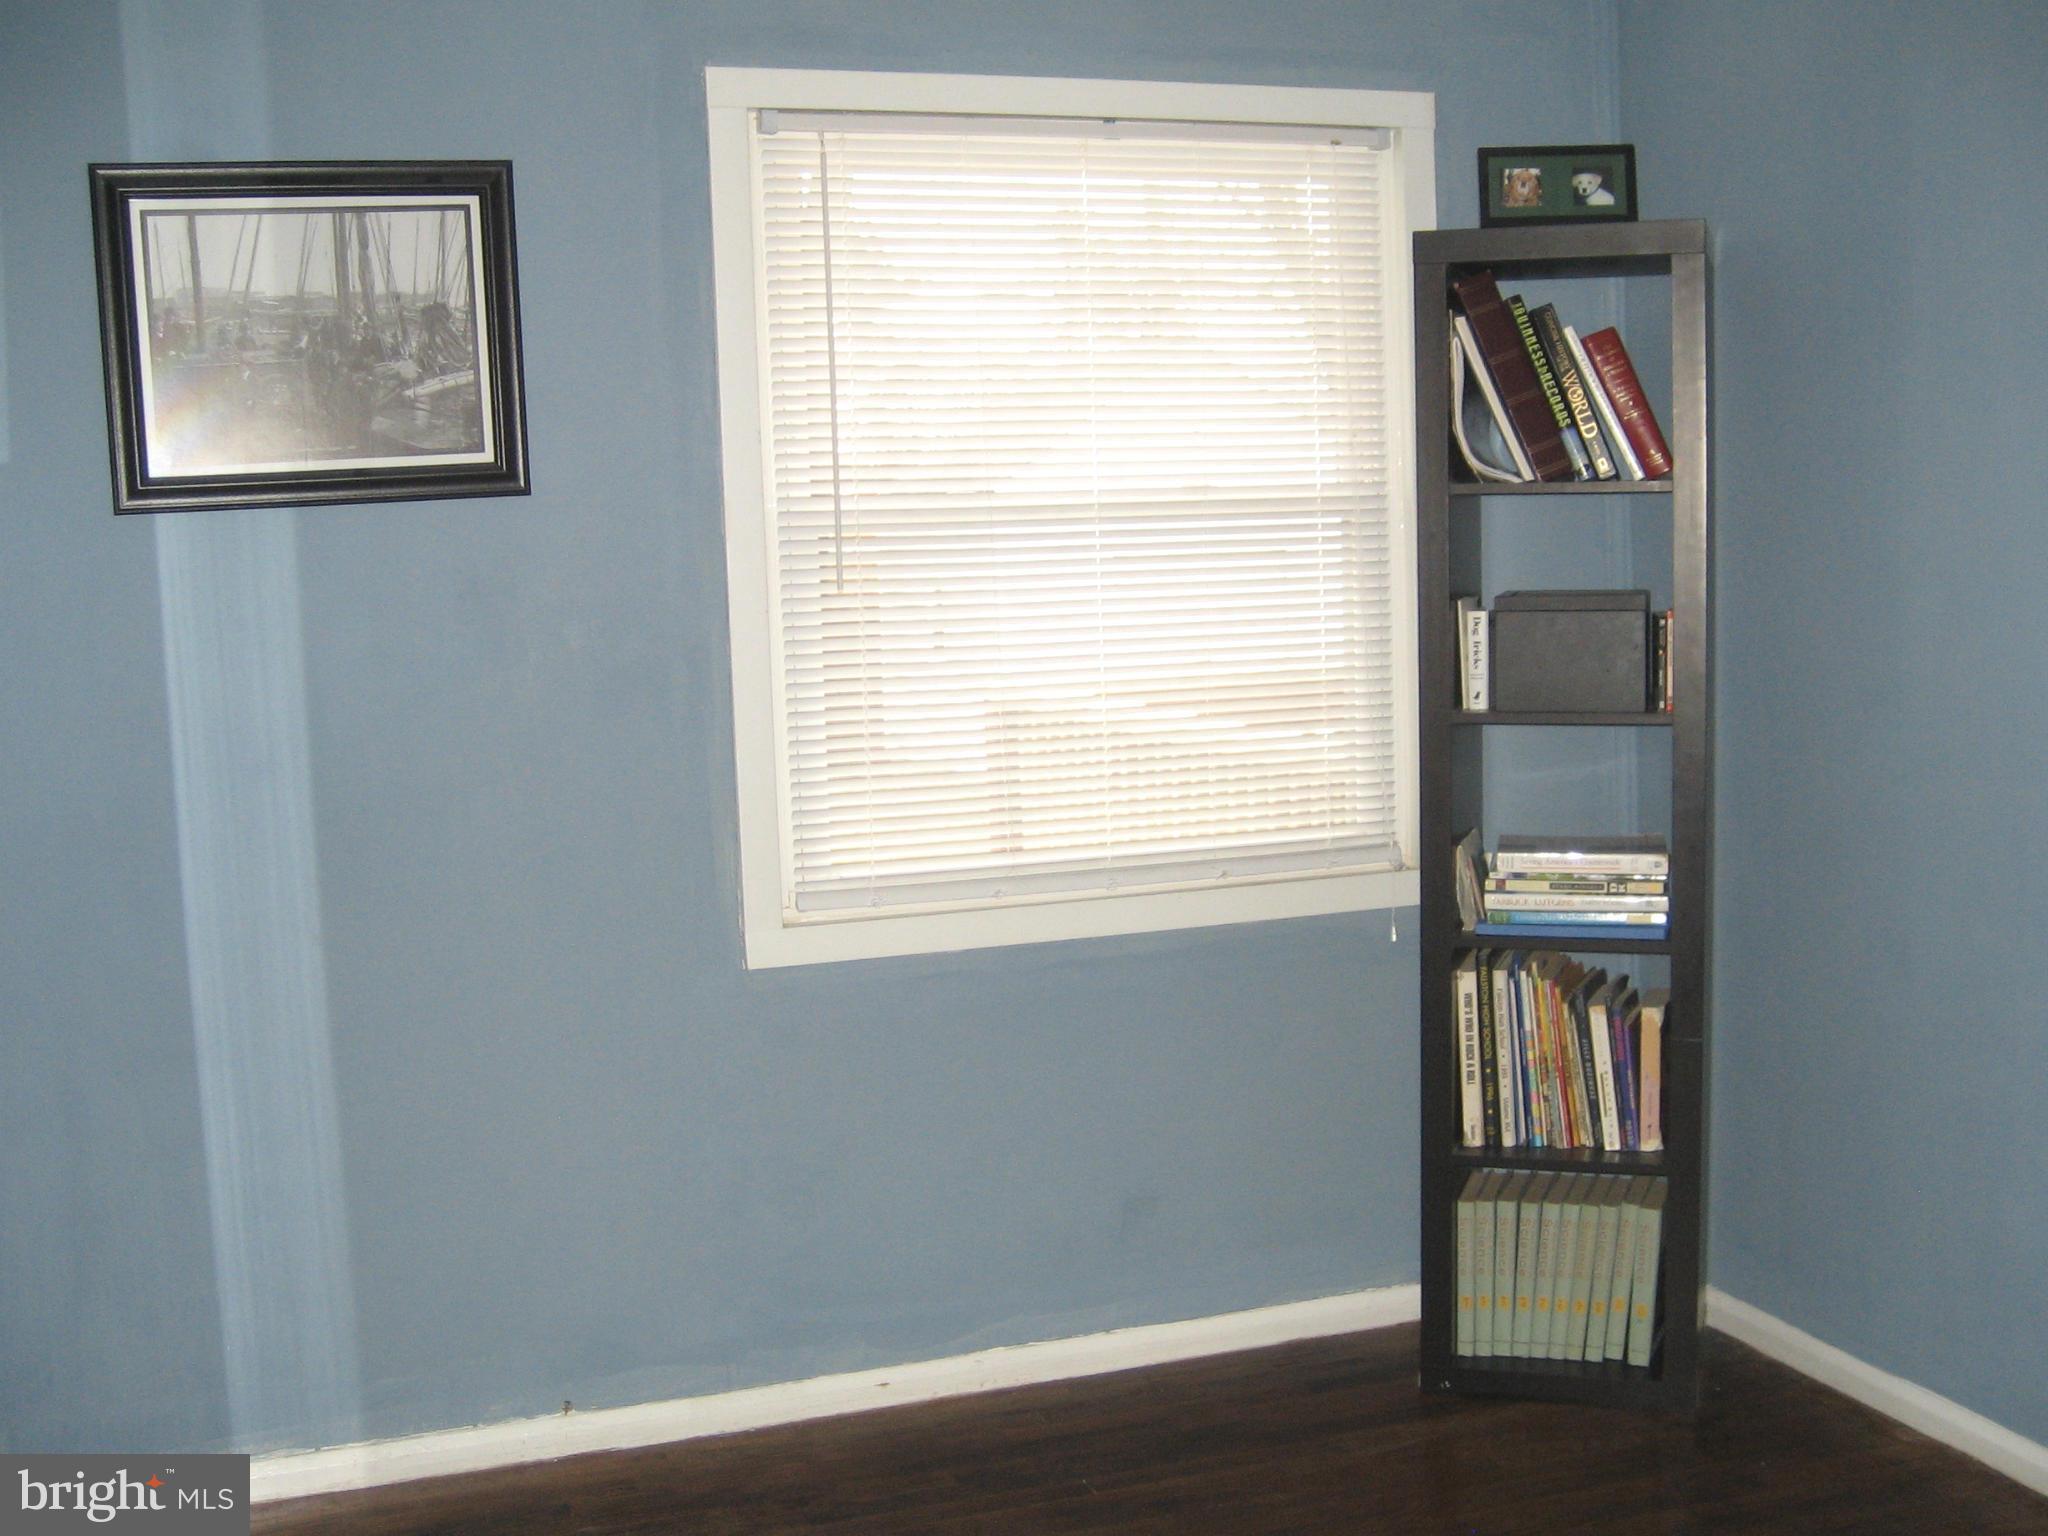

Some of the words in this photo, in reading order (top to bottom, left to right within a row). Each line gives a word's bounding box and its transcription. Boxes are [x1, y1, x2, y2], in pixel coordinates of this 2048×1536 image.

[1513, 307, 1544, 366] GUINNESS
[1540, 372, 1572, 429] RECORDS
[1561, 370, 1599, 439] WORLD
[1472, 616, 1481, 635] Dog
[1473, 641, 1482, 670] Tricks
[1479, 966, 1489, 1003] FALLSTON
[1464, 1017, 1474, 1033] WHO
[1481, 1005, 1490, 1025] HIGH
[1465, 1034, 1474, 1042] IN
[1483, 1027, 1492, 1060] SCHOOL
